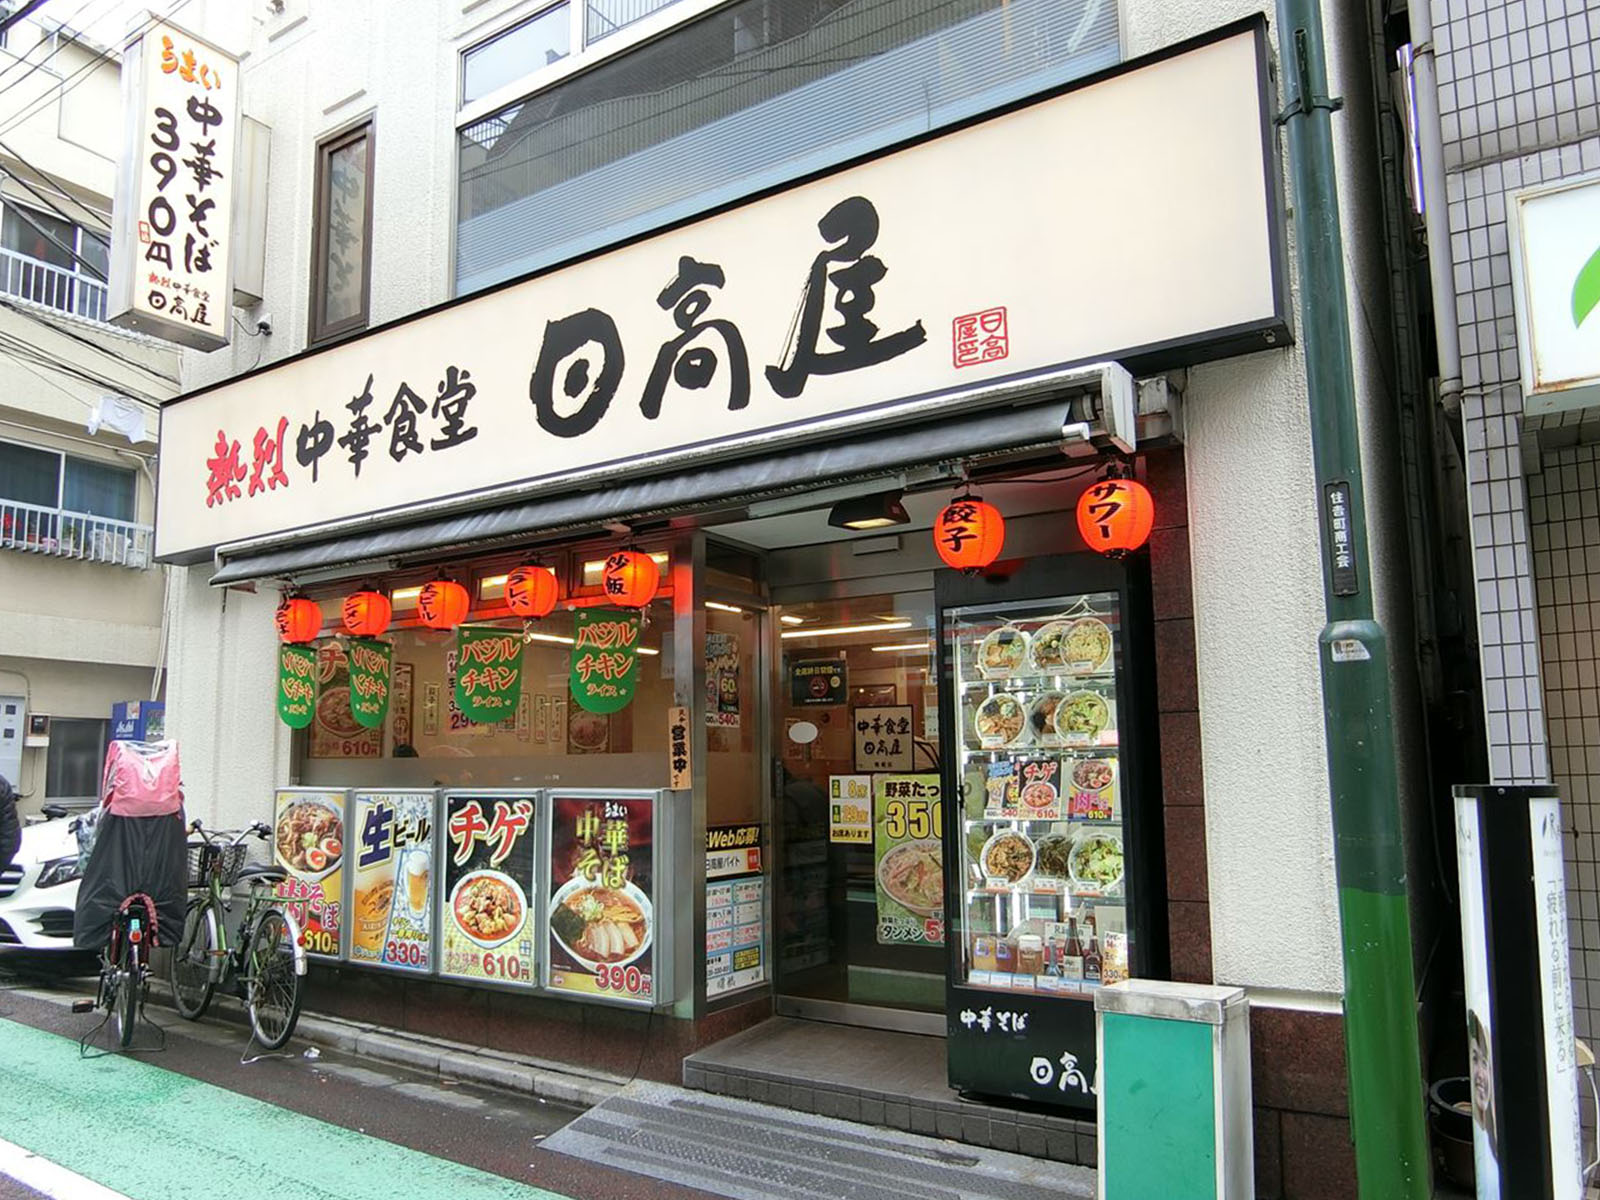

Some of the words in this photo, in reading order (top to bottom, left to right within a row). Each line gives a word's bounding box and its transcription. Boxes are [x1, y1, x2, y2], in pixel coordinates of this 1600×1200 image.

[161, 34, 221, 91] うまい
[145, 107, 180, 271] 390円
[182, 96, 223, 274] 中華そば
[148, 290, 212, 326] 日高屋
[529, 195, 927, 438] 日高屋
[1088, 483, 1127, 539] サワー
[942, 504, 978, 552] 餃子
[605, 554, 630, 595] 炒飯
[575, 622, 638, 648] バジル
[460, 637, 520, 665] バジル
[460, 667, 518, 695] チキン
[576, 652, 634, 683] チキン
[857, 713, 911, 736] 中華食堂
[672, 725, 687, 773] 営業中
[864, 738, 903, 756] 日高屋
[604, 801, 628, 818] うまい
[359, 802, 431, 867] 生ビール
[450, 800, 534, 868] チゲ
[706, 827, 760, 848] Web応募!
[883, 925, 924, 939] タンメン
[386, 941, 428, 966] 330円
[482, 952, 530, 980] 610円
[595, 963, 651, 994] 390円
[960, 1006, 1029, 1032] 中華そば
[1030, 1051, 1097, 1095] 日高
